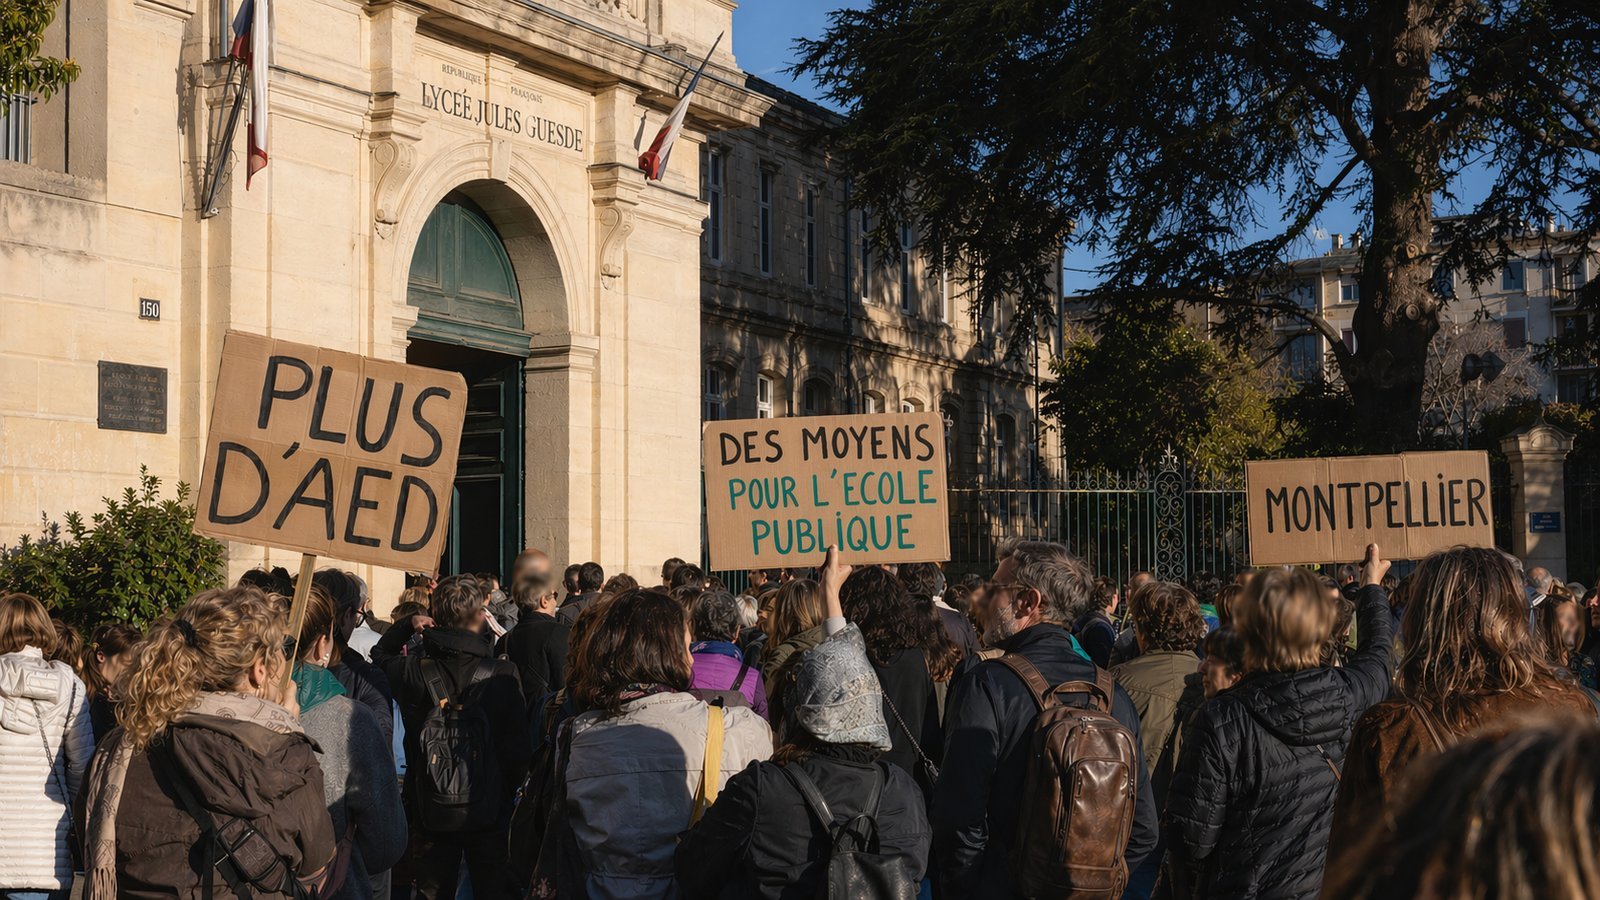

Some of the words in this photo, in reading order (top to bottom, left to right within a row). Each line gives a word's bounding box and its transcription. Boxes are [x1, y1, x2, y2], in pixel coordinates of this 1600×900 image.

[421, 82, 472, 120] LYCÉE
[474, 99, 521, 134] JULES
[525, 114, 583, 152] GUESDE
[141, 300, 159, 317] 150
[258, 355, 451, 468] PLUS
[719, 429, 783, 466] DES
[802, 423, 935, 462] MOYENS
[208, 441, 438, 552] D'AED
[729, 476, 799, 510] POUR
[812, 468, 937, 507] L'ECOLE
